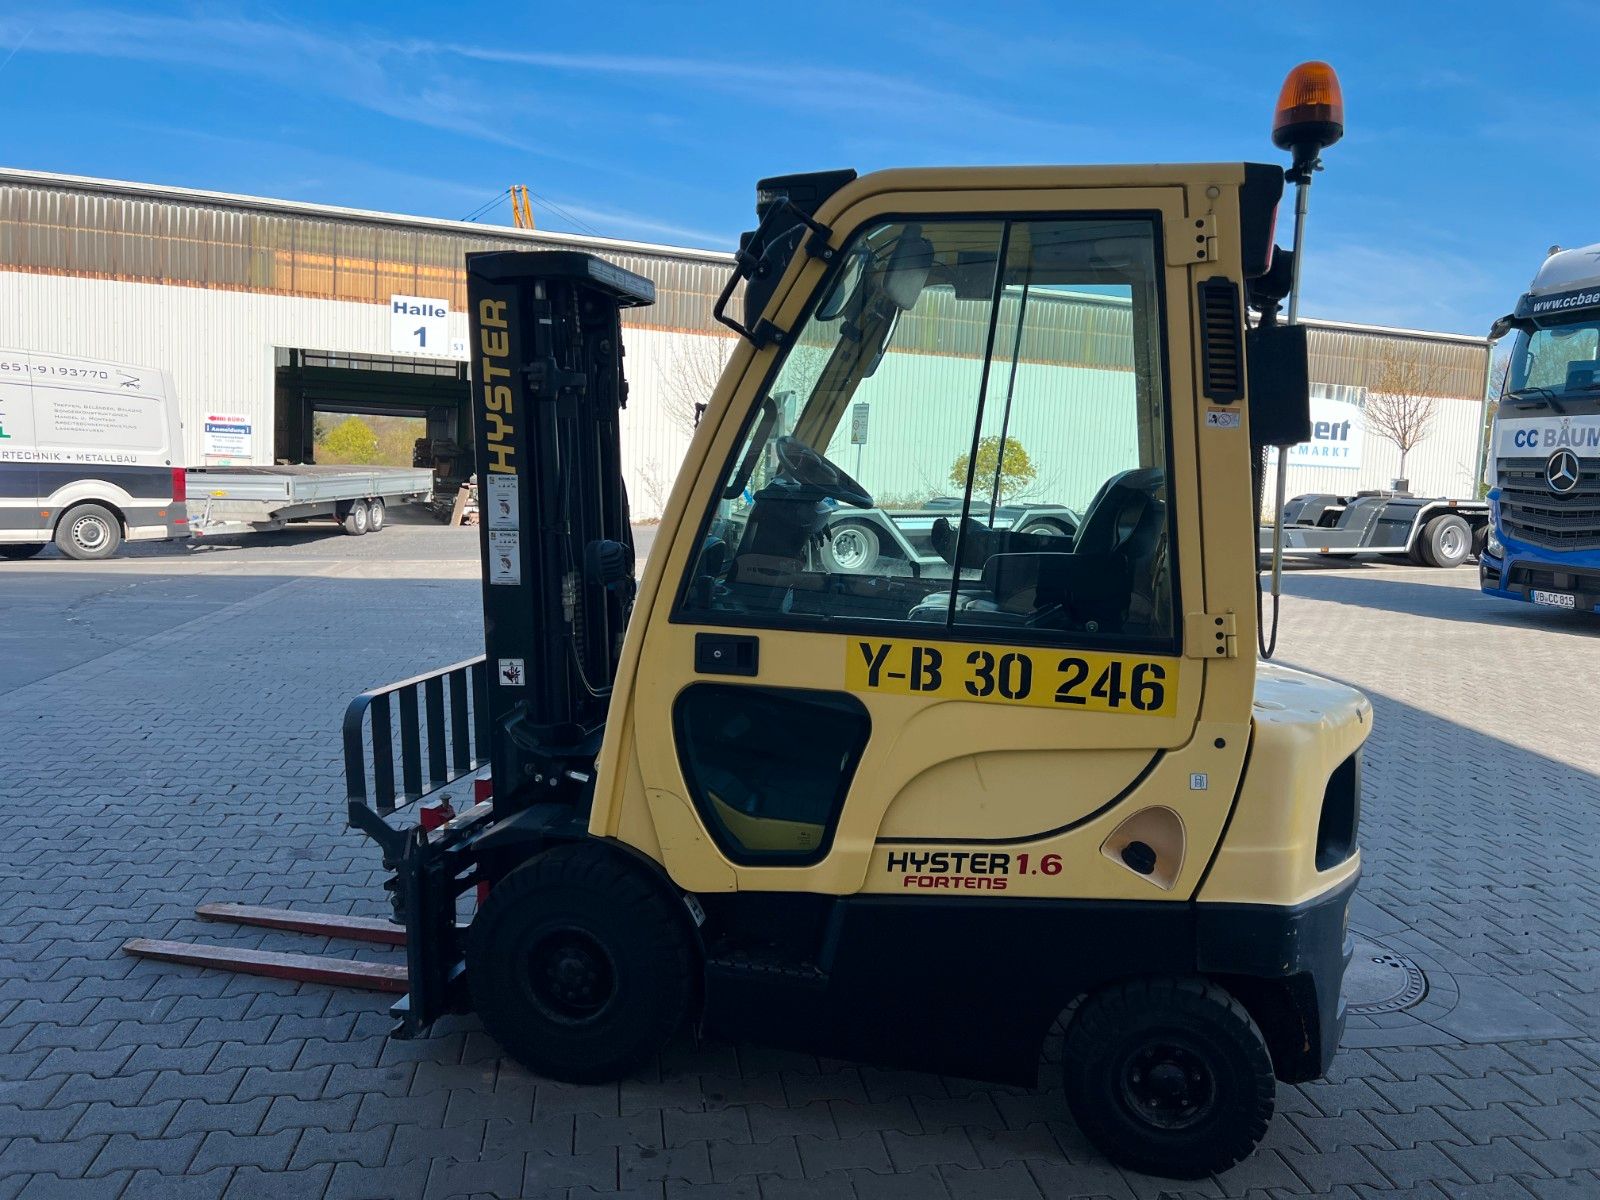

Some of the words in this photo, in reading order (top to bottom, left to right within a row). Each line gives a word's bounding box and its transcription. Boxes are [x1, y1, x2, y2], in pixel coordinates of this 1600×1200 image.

[393, 301, 447, 318] Halle
[413, 326, 426, 348] 1
[0, 362, 109, 380] 651-9193770
[479, 298, 517, 475] HYSTER
[1310, 419, 1351, 441] ert
[1514, 429, 1539, 448] CC
[2, 450, 61, 461] RTECHNIK
[76, 453, 138, 464] METALLBAU
[859, 642, 943, 692] Y-B
[965, 650, 1033, 700] 30
[1055, 657, 1166, 711] 246
[887, 851, 1011, 875] HYSTER
[1016, 853, 1063, 876] 1.6
[903, 875, 1008, 890] FORTENS
